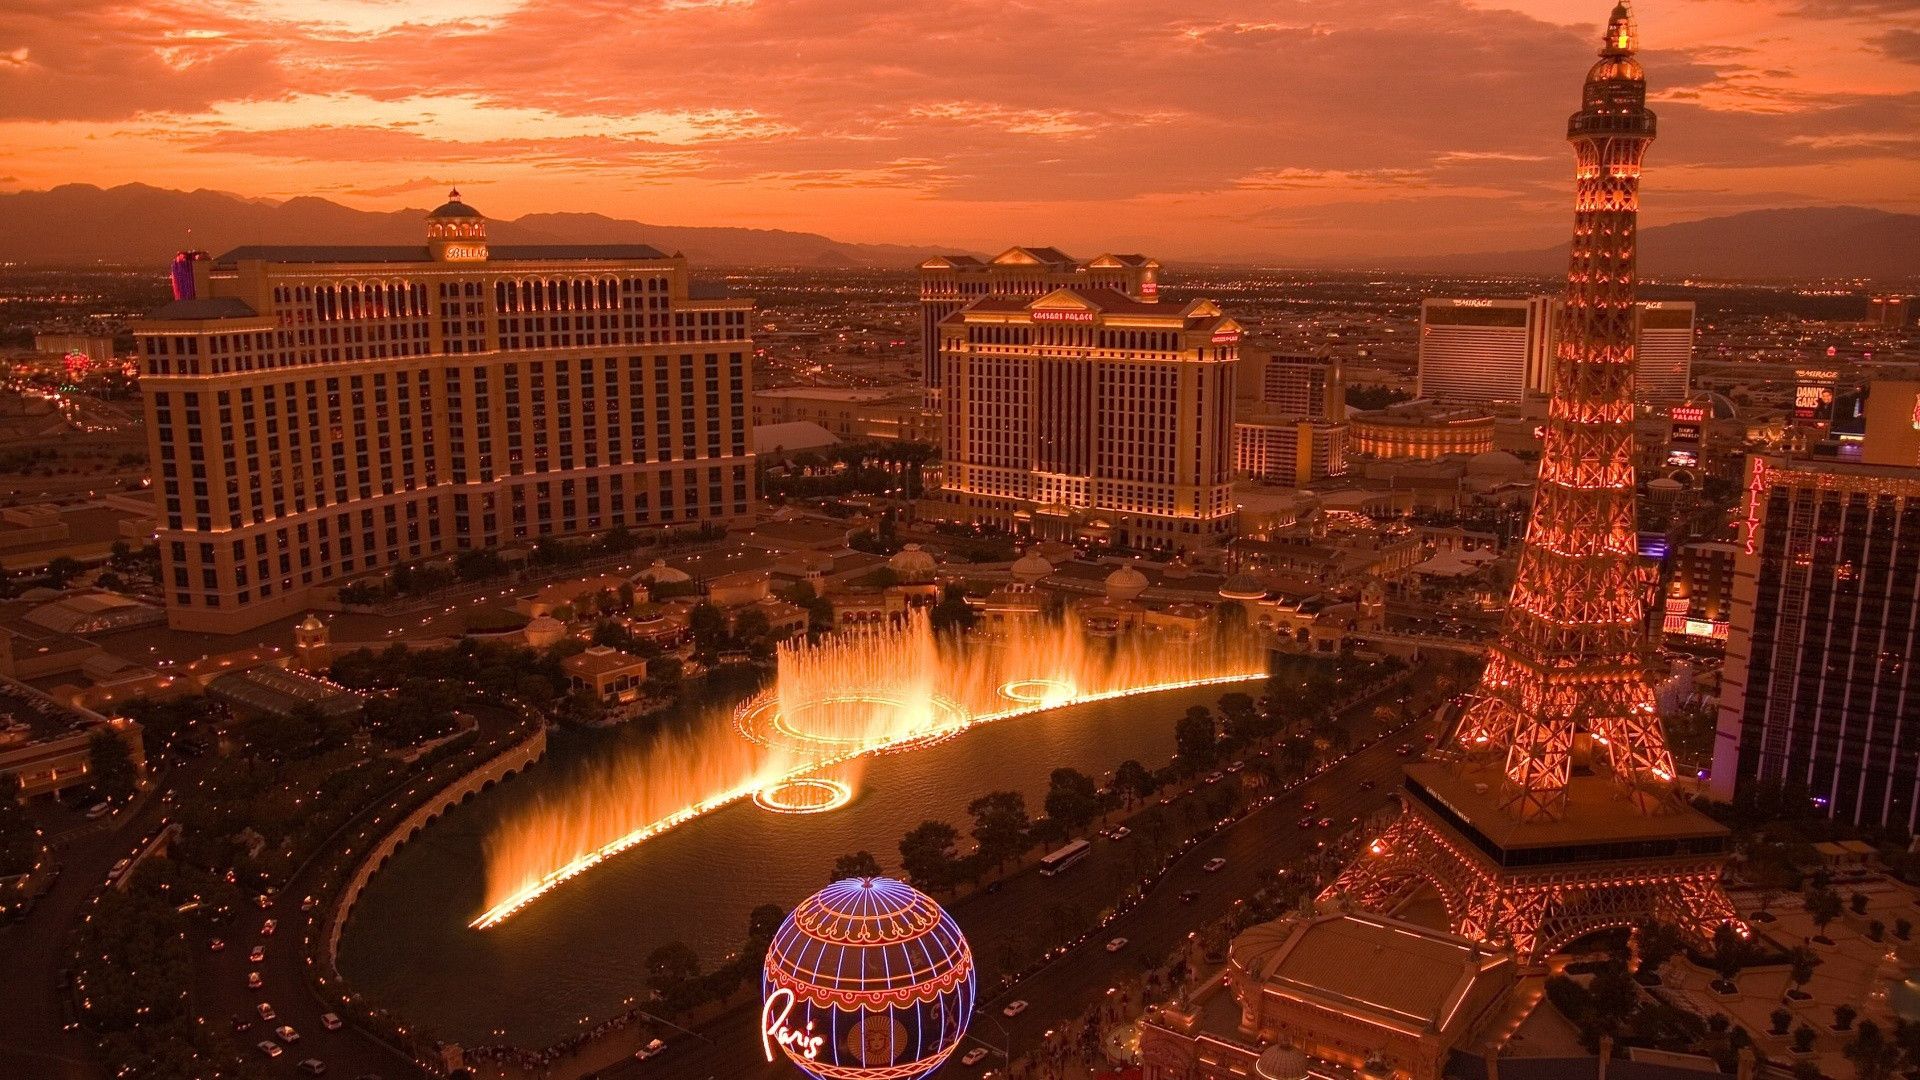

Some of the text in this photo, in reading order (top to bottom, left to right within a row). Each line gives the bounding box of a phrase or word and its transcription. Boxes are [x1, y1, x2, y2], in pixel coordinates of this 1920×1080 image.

[1461, 299, 1493, 307] MIRAGE
[1033, 312, 1063, 320] CAESARS
[1805, 370, 1839, 378] MIRAGE
[1796, 386, 1825, 399] DANNY
[1795, 397, 1819, 408] GANS
[1672, 407, 1704, 415] CAESARS
[762, 988, 824, 1062] Paris
